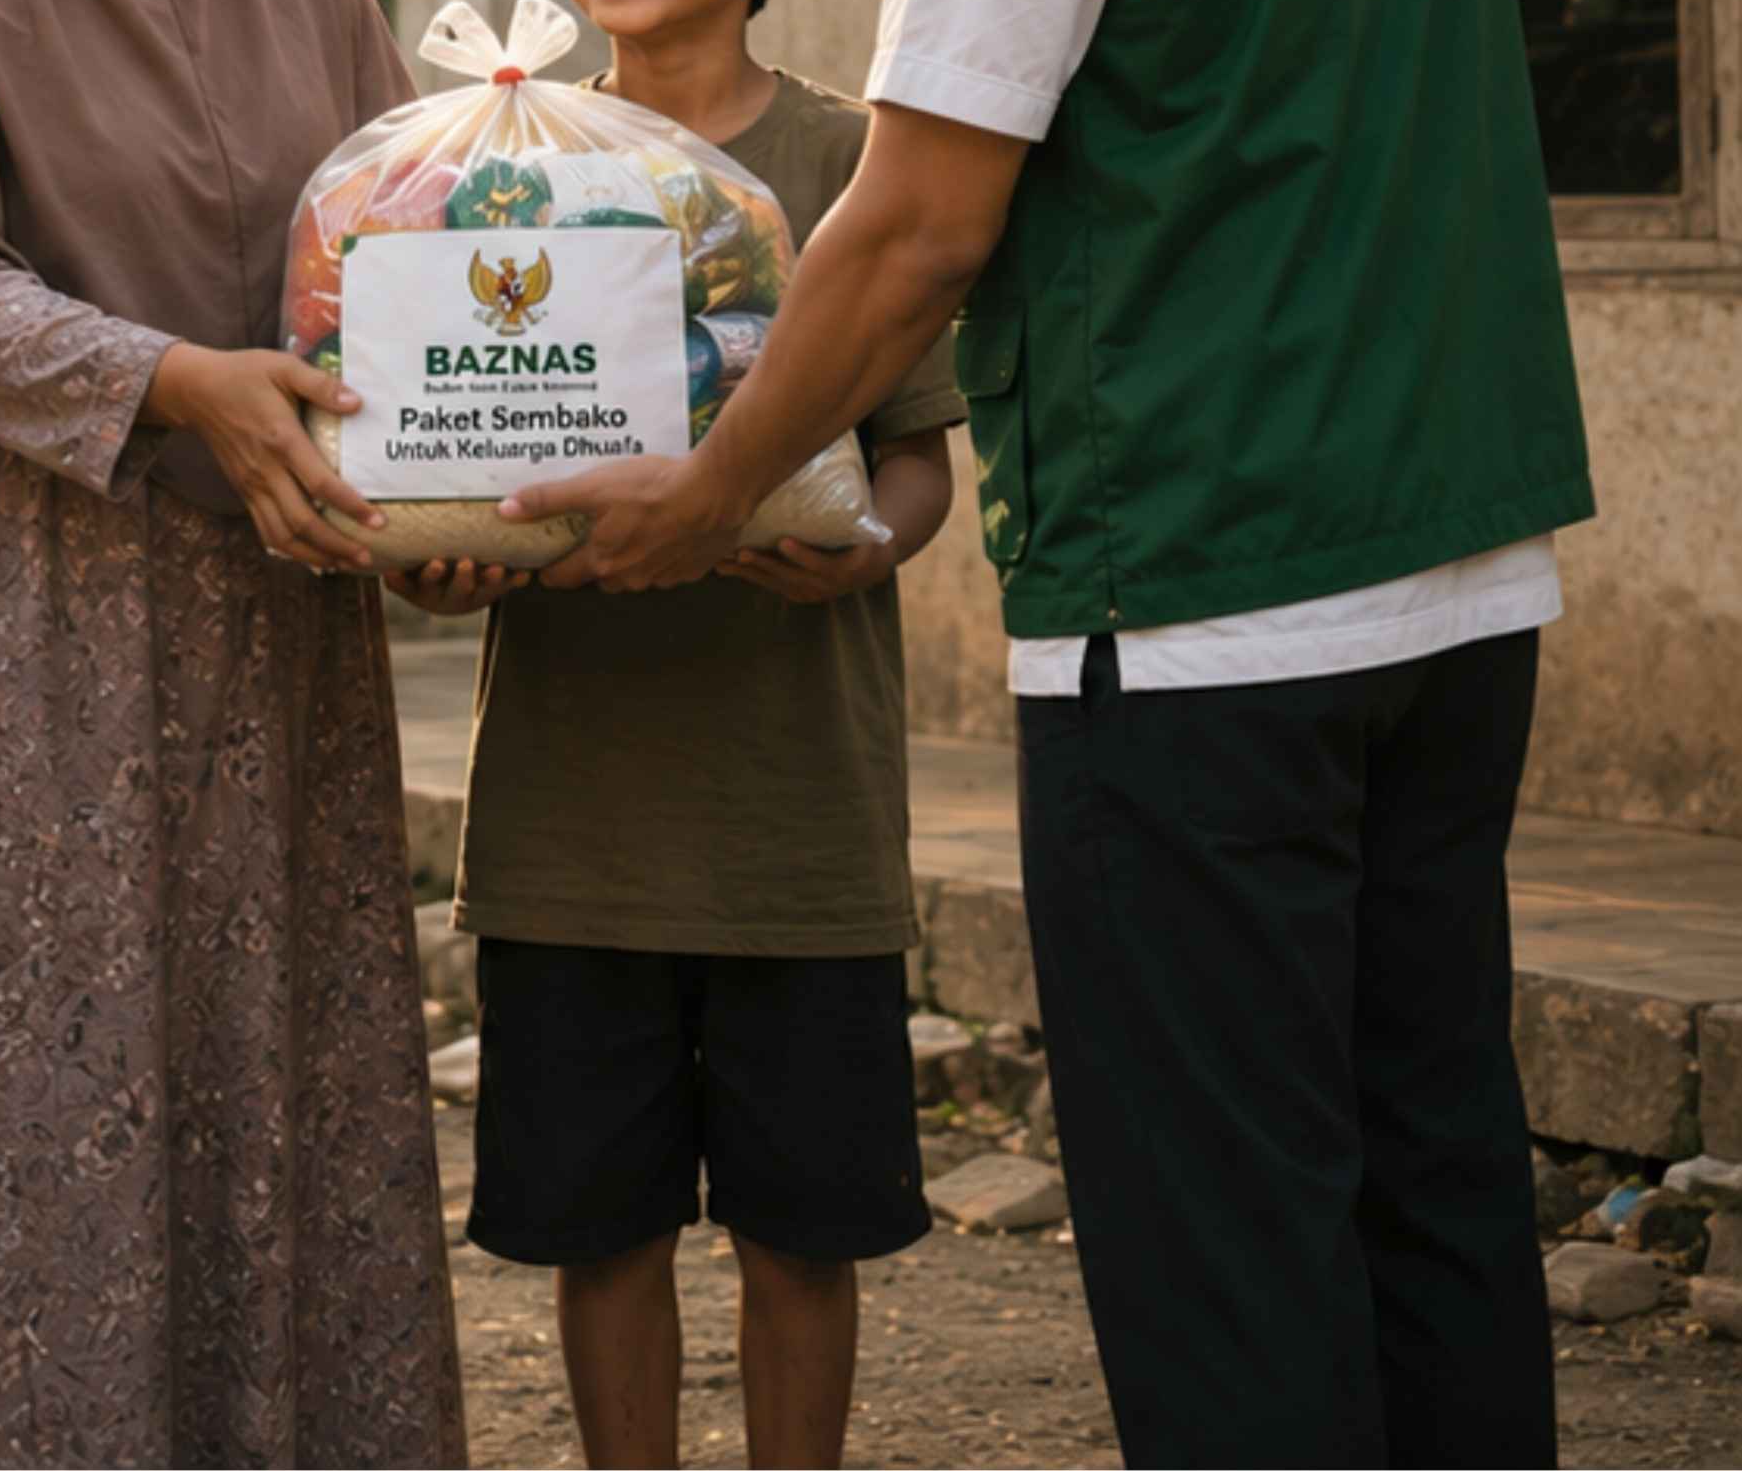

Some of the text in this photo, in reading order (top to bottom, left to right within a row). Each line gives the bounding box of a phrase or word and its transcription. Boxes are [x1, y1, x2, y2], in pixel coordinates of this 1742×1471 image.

[425, 343, 597, 377] BAZNAS
[400, 403, 628, 432] Paket Sembako
[385, 436, 643, 464] Untuk Keluarga Dhuafa
